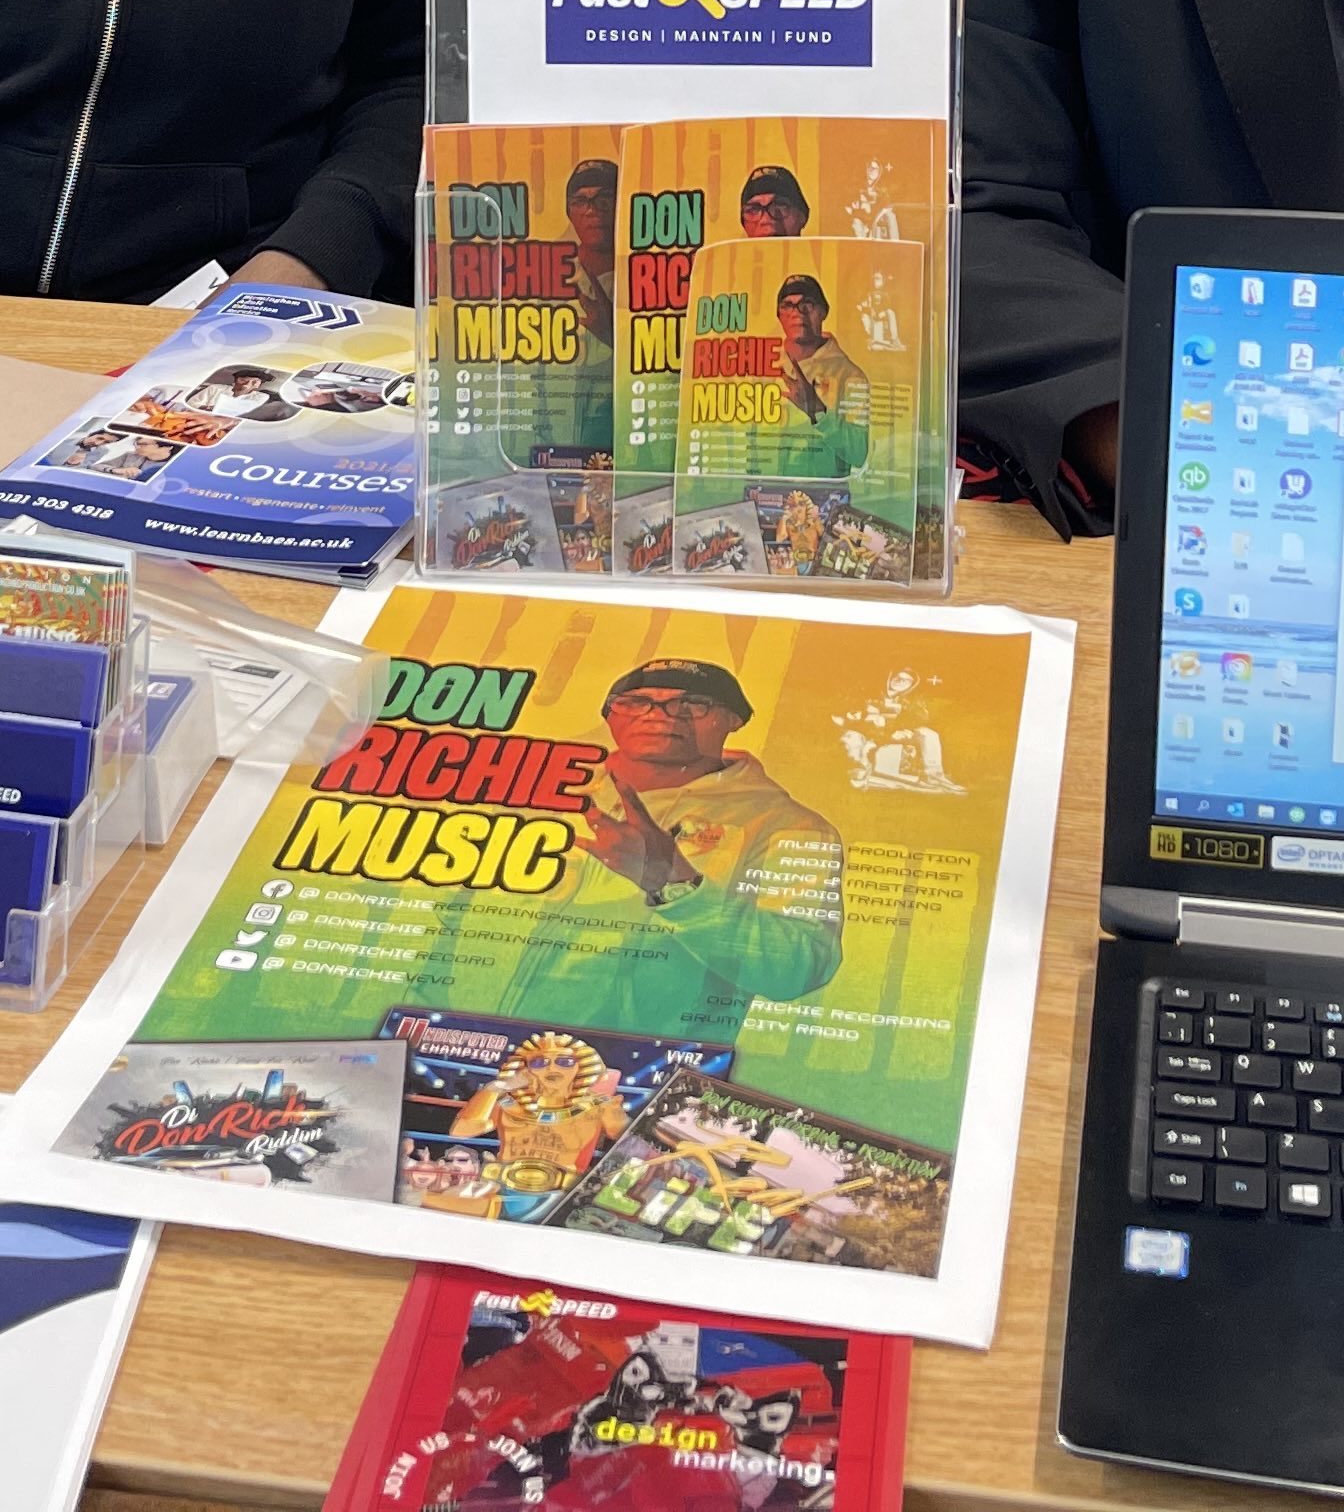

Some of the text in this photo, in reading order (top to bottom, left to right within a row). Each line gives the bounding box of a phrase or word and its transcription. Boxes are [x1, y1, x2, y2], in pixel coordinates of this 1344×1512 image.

[586, 29, 833, 44] DESIGN MAINTAIN FUND
[450, 182, 528, 239] DON
[630, 189, 704, 250] DON
[450, 241, 578, 300] RICHIE
[696, 293, 747, 335] DON
[454, 304, 578, 364] MUSIC
[693, 336, 784, 378] RICHIE
[691, 382, 783, 424] MUSIC
[209, 454, 414, 494] Courses
[34, 495, 69, 513] 303
[183, 487, 232, 500] restart
[144, 516, 355, 551] www.learnbaes.ac.uk
[376, 657, 536, 730] DON
[312, 723, 608, 813] RICHIE
[273, 797, 576, 893] MUSIC
[778, 839, 973, 867] MUSIC PRODUCTION
[1157, 838, 1250, 860] HD 1080
[746, 868, 818, 884] MIXING
[847, 879, 965, 900] MASTERING
[779, 856, 965, 883] RADIO BROADCAST
[325, 891, 675, 936] DONRICHIERECORDINGPRODUCTION
[736, 881, 943, 912] IN-STUDIO TRAINING
[782, 905, 911, 927] VOICE OVERS
[303, 938, 496, 967] DONRICHIERECORD
[314, 915, 670, 961] DONRICHIERECORDINGPRODUCTION
[292, 960, 455, 986] DONRICHIEVEVO
[679, 1012, 859, 1042] BRUM CITY RADIO
[706, 995, 952, 1031] DON RICHIE RECORDING
[420, 1042, 502, 1063] CHAMPION
[245, 1126, 323, 1155] Riddim
[473, 1290, 618, 1320] Fast SPEED
[596, 1416, 718, 1451] design
[383, 1430, 450, 1500] JOIN US
[487, 1433, 545, 1505] JOIN US
